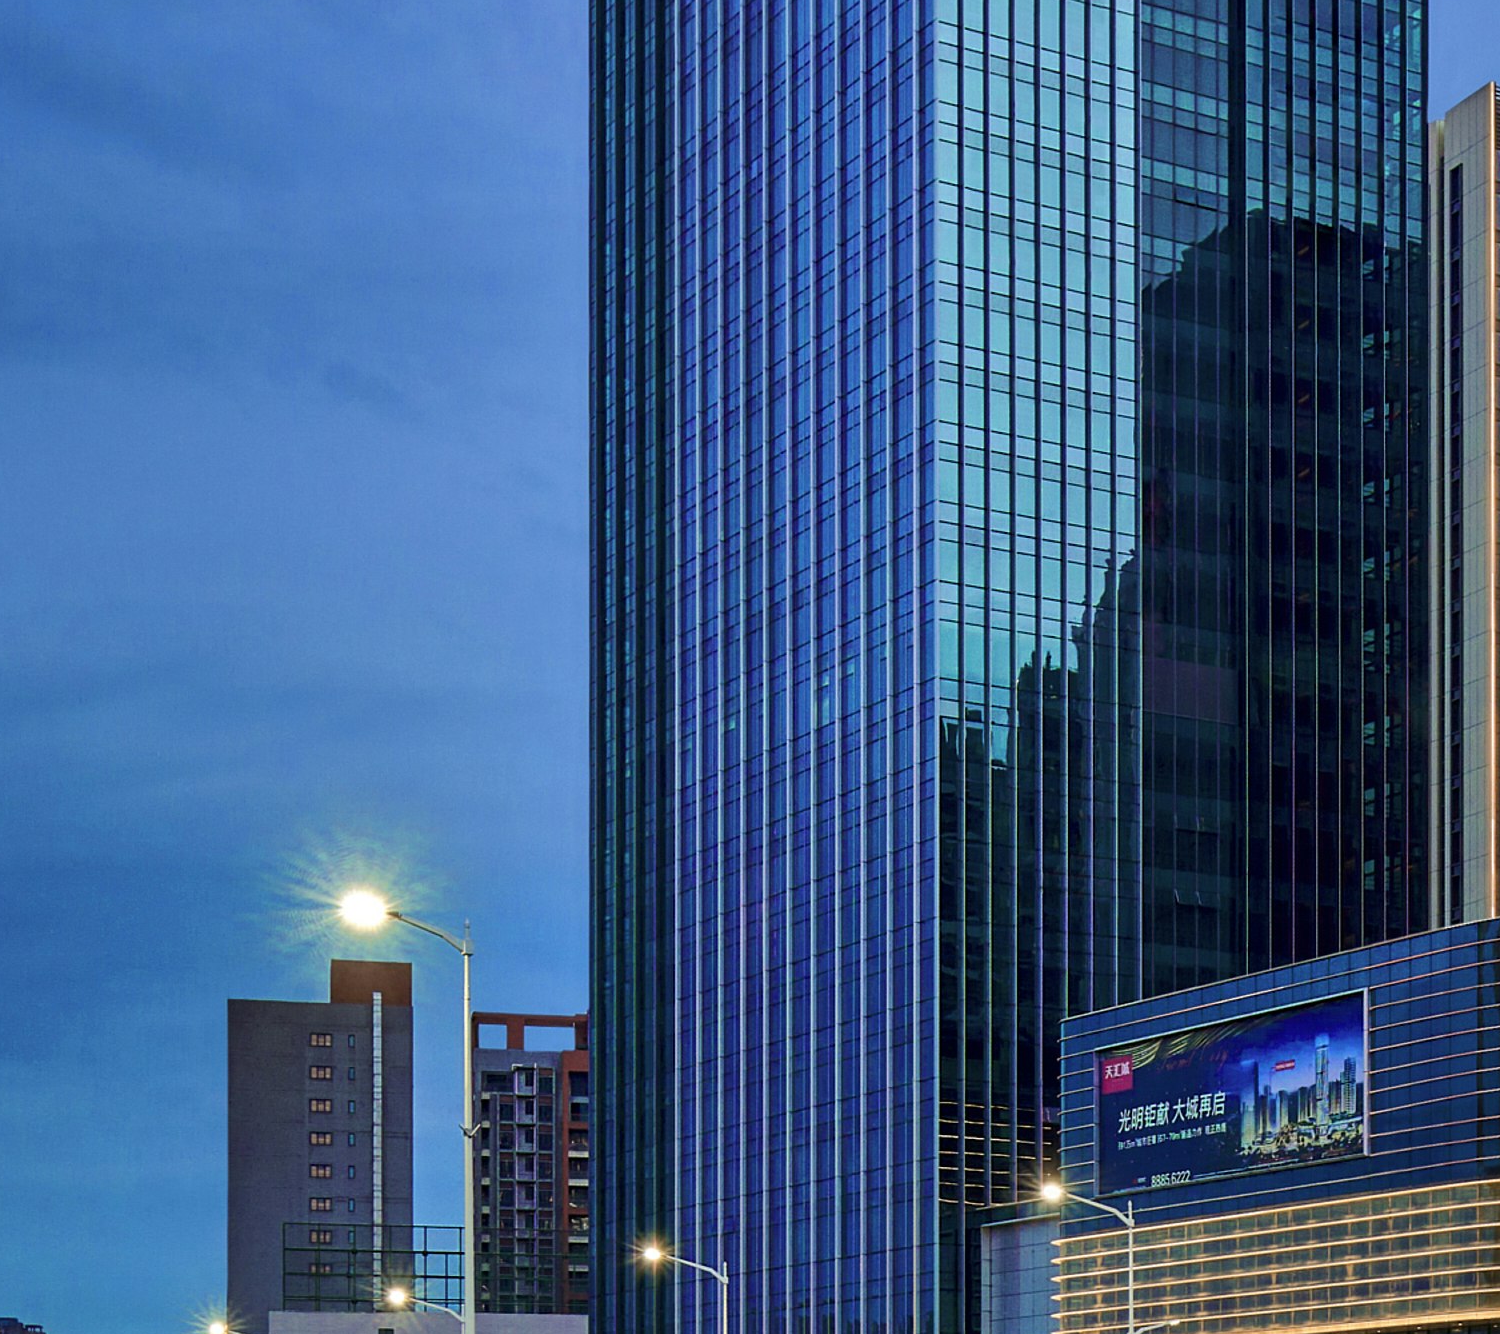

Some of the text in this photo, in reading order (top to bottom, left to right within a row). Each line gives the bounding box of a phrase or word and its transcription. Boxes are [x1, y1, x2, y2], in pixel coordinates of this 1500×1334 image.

[1118, 1091, 1226, 1133] 光明钜献 大城再启
